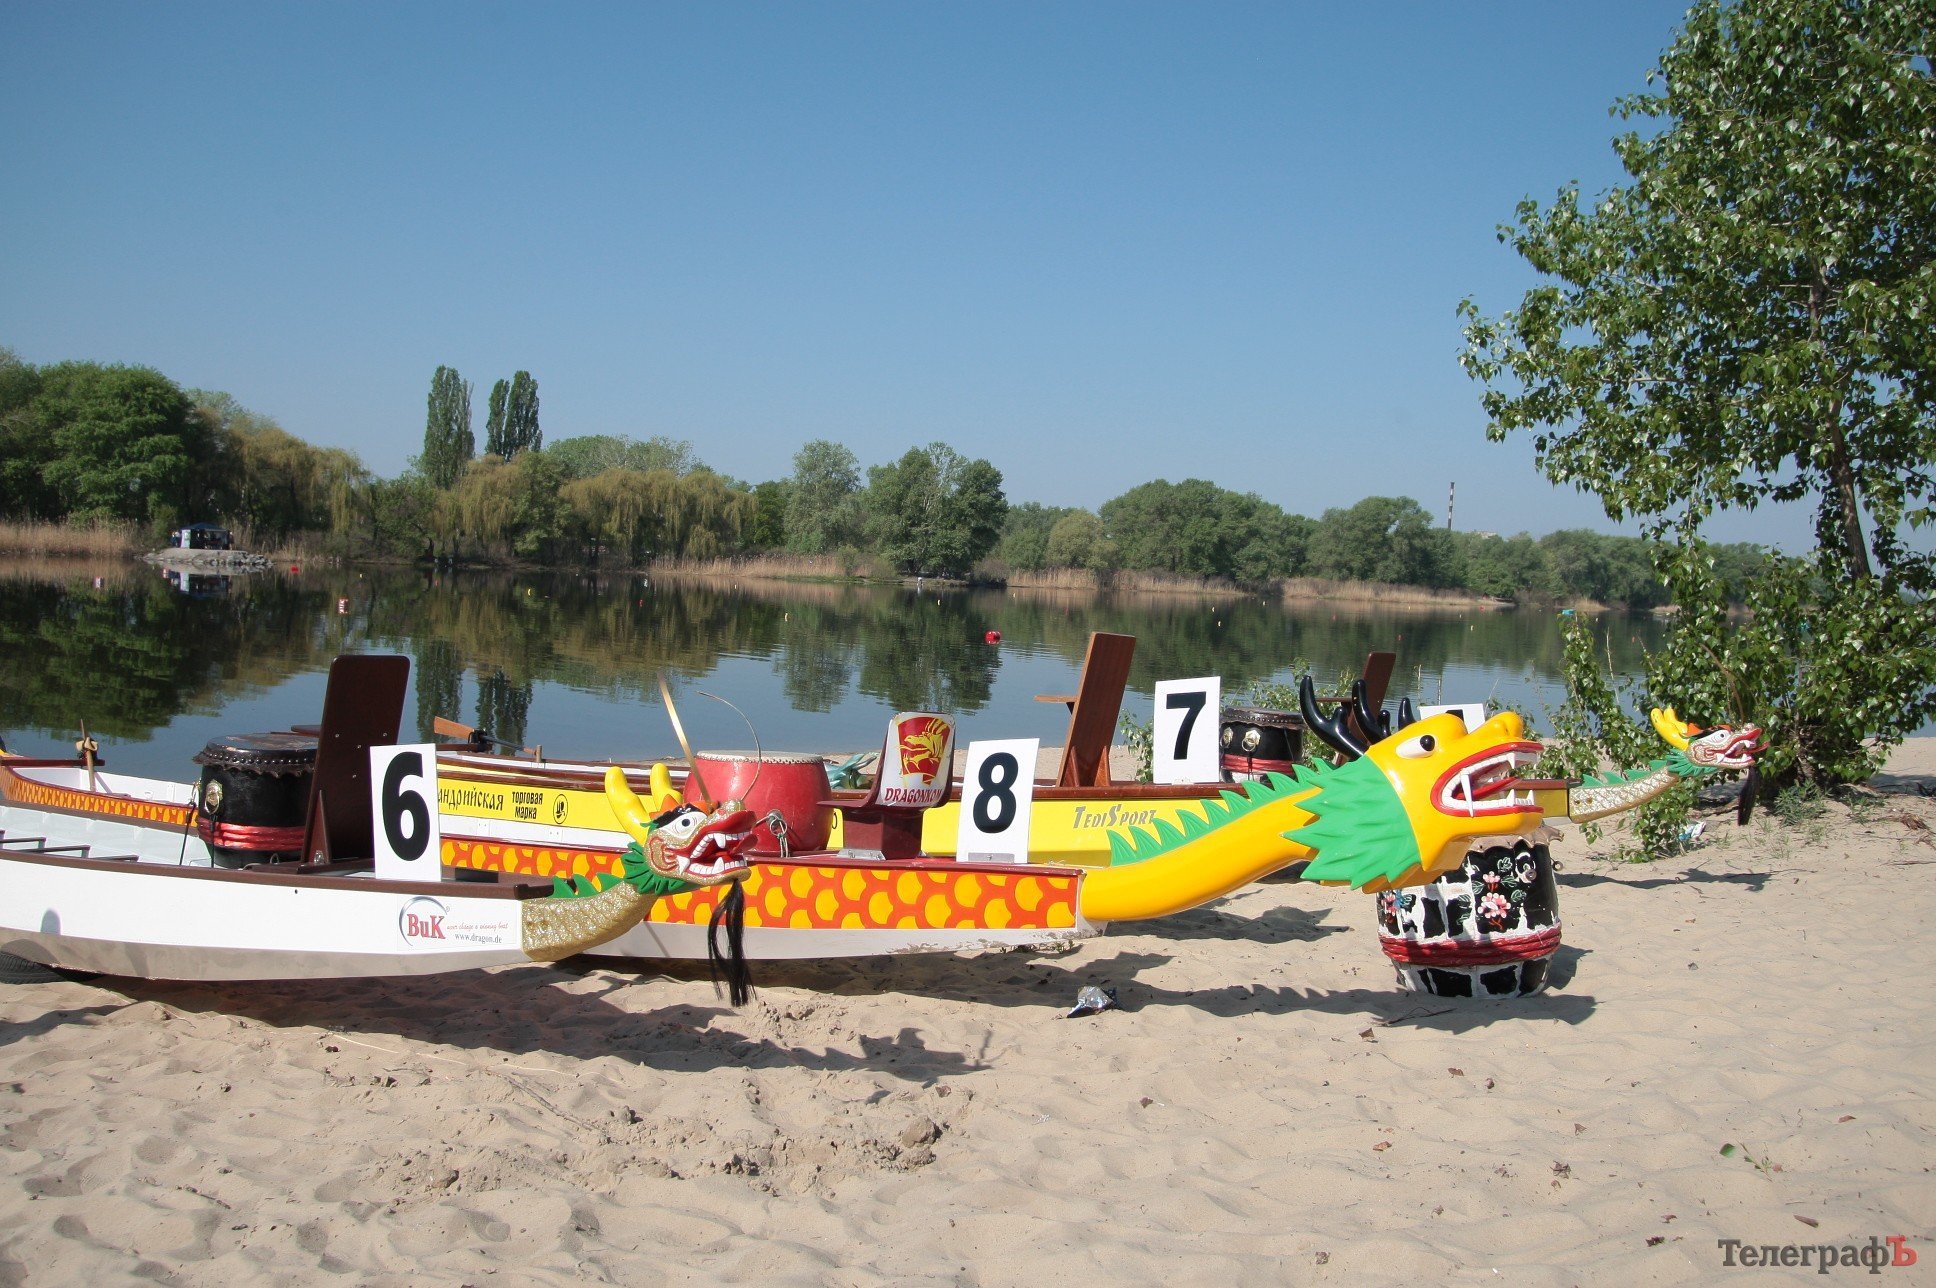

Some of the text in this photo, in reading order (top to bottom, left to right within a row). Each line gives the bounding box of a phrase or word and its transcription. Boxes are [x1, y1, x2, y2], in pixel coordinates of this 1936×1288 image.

[1166, 691, 1206, 760] 7
[382, 751, 430, 862] 6
[515, 806, 538, 820] марка
[973, 752, 1018, 833] 8
[407, 913, 446, 939] BuK
